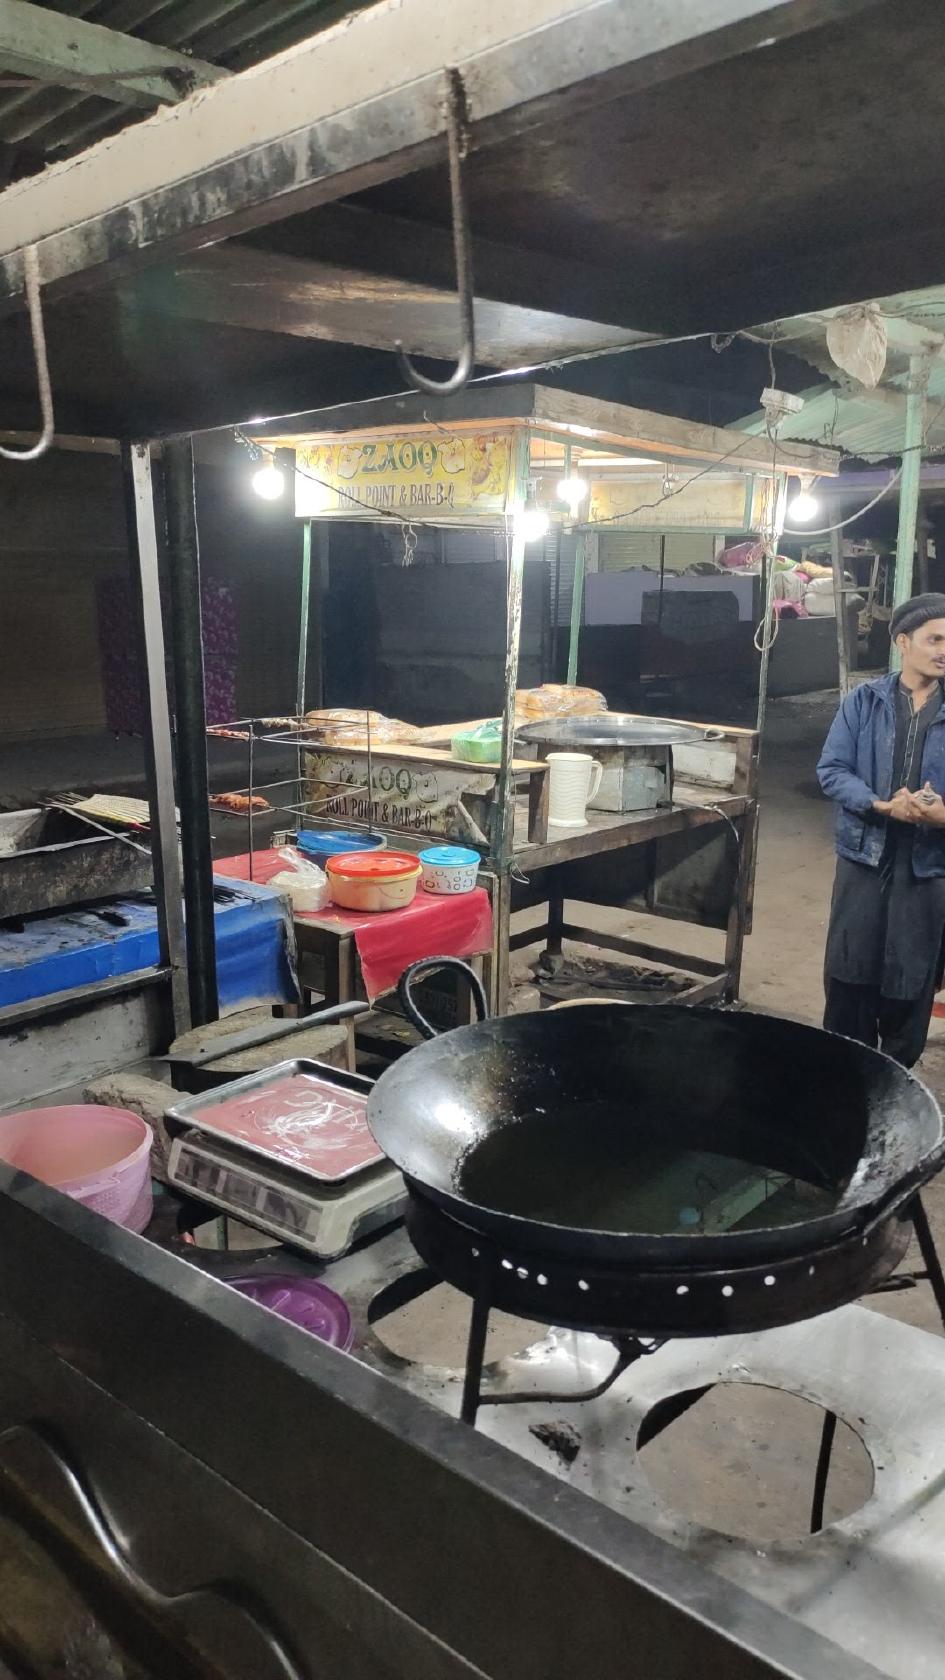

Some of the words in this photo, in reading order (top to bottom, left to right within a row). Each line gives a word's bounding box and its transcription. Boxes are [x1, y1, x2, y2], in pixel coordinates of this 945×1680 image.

[361, 440, 438, 478] ZAOQ
[365, 483, 396, 507] POINT
[399, 483, 407, 506] &
[326, 794, 349, 816] ROLL
[351, 797, 380, 822] POINT
[381, 802, 389, 823] &
